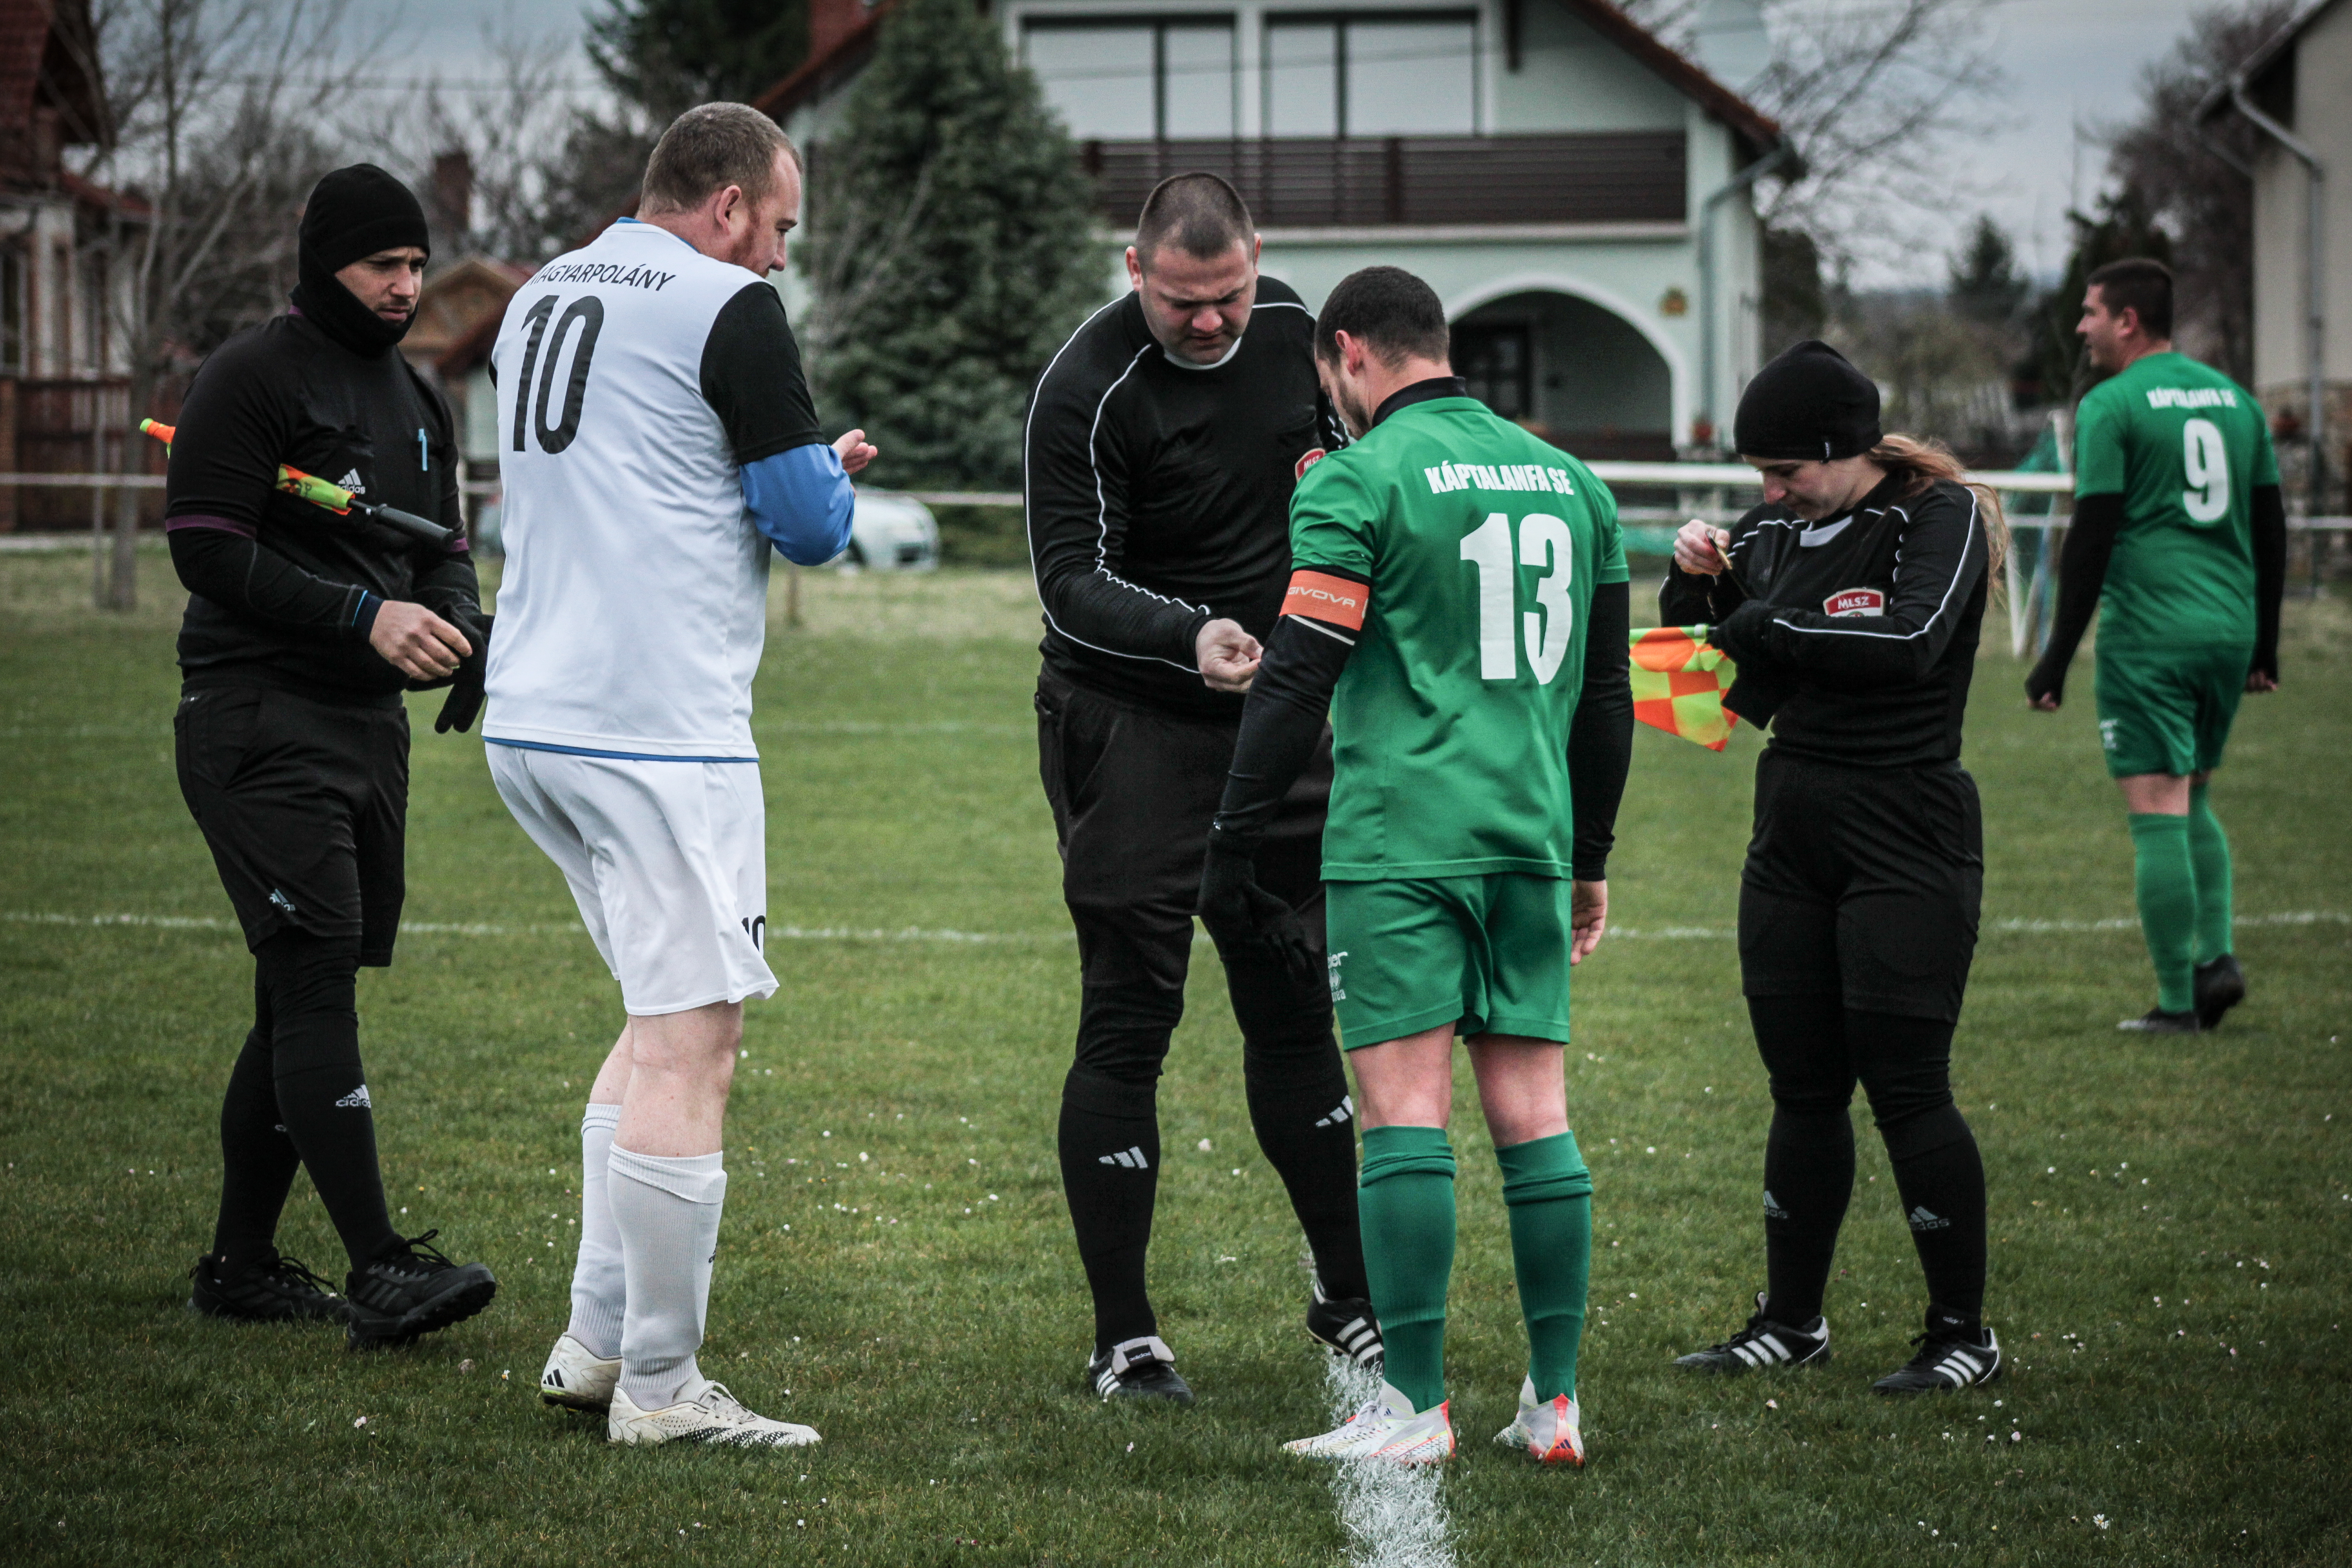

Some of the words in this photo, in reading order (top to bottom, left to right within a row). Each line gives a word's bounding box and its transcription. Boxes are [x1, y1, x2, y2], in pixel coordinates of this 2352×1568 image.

[527, 264, 676, 291] MAGYARPOLÁNY
[513, 295, 604, 455] 10
[1424, 460, 1552, 494] KÁPTALANFA
[1546, 467, 1574, 495] SE
[2183, 418, 2230, 523] 9
[1288, 586, 1356, 608] GIVOVA
[1460, 513, 1572, 685] 13
[1838, 596, 1870, 609] MLSZ
